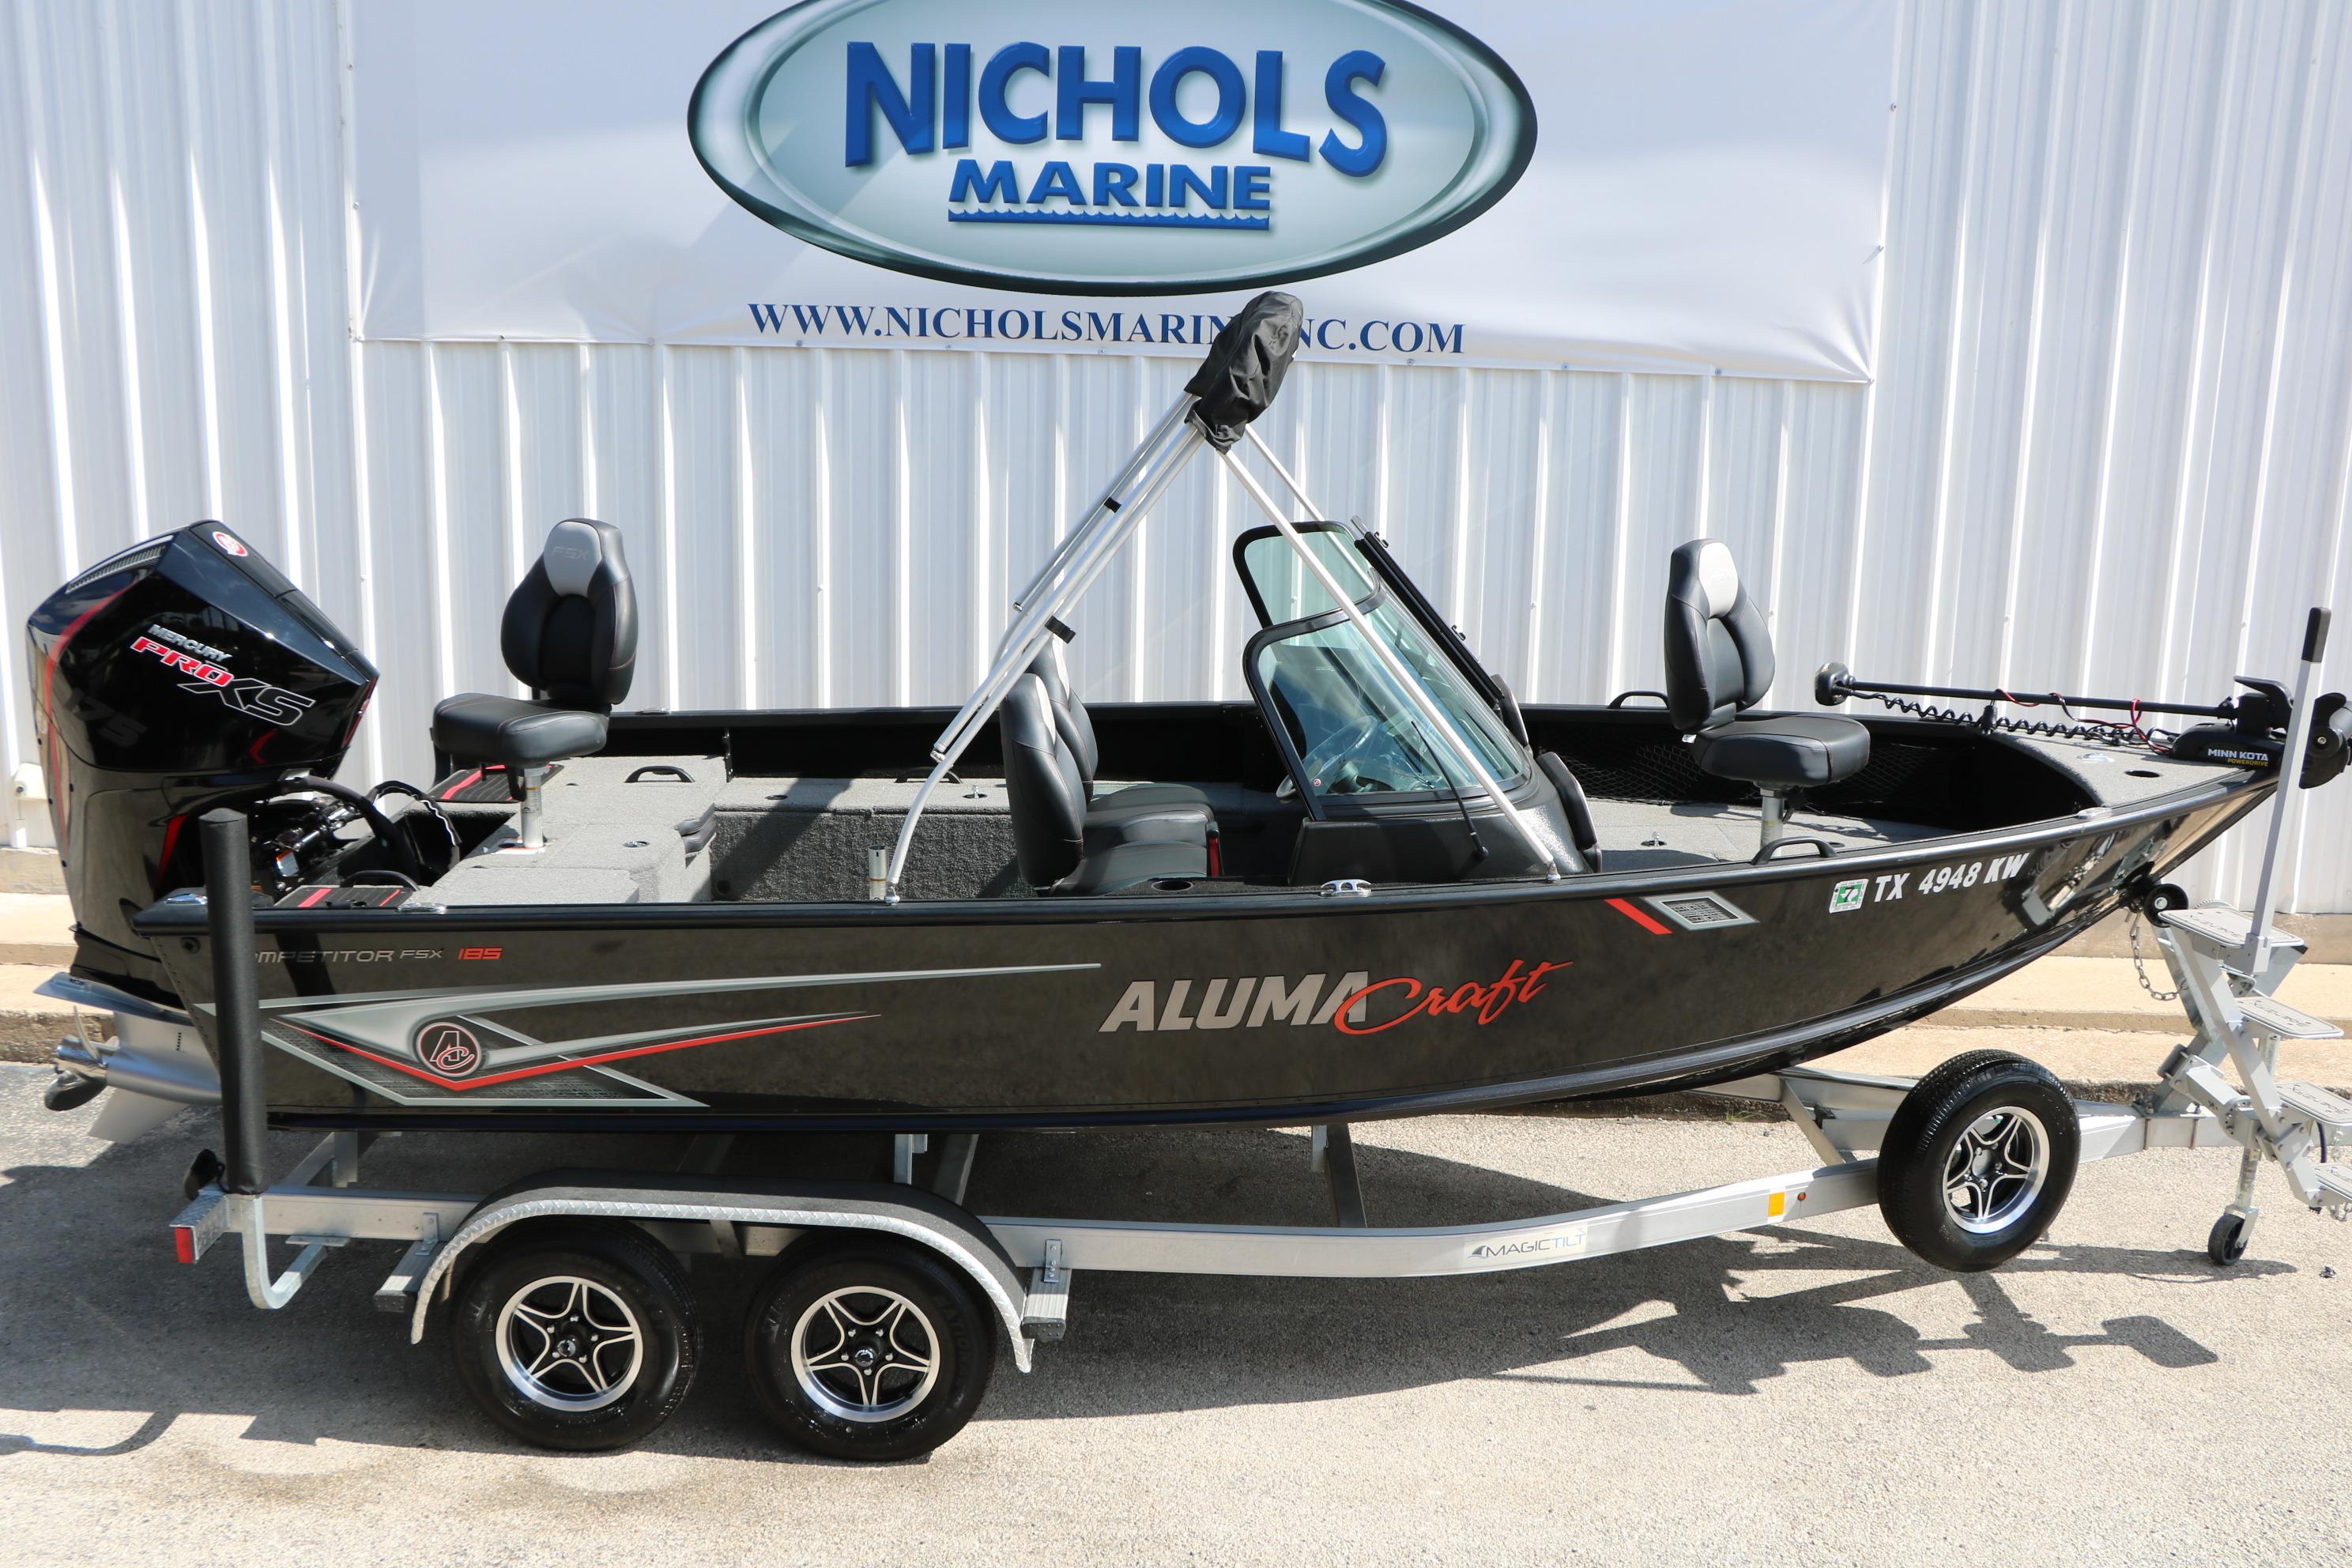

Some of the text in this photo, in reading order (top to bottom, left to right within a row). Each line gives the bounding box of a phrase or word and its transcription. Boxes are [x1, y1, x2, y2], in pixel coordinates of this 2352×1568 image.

[845, 41, 1388, 178] NICHOLS
[948, 158, 1272, 210] MARINE
[130, 636, 235, 688] PRO
[147, 624, 233, 662] MERCURY
[176, 677, 316, 726] XS
[2207, 748, 2269, 762] MINN KOTA
[2227, 758, 2269, 767] POWERDRIVE
[1874, 852, 2030, 903] TX 4948 KW
[254, 947, 503, 963] MPETITOR FSX 185
[1485, 1234, 1585, 1258] MAGICTILT
